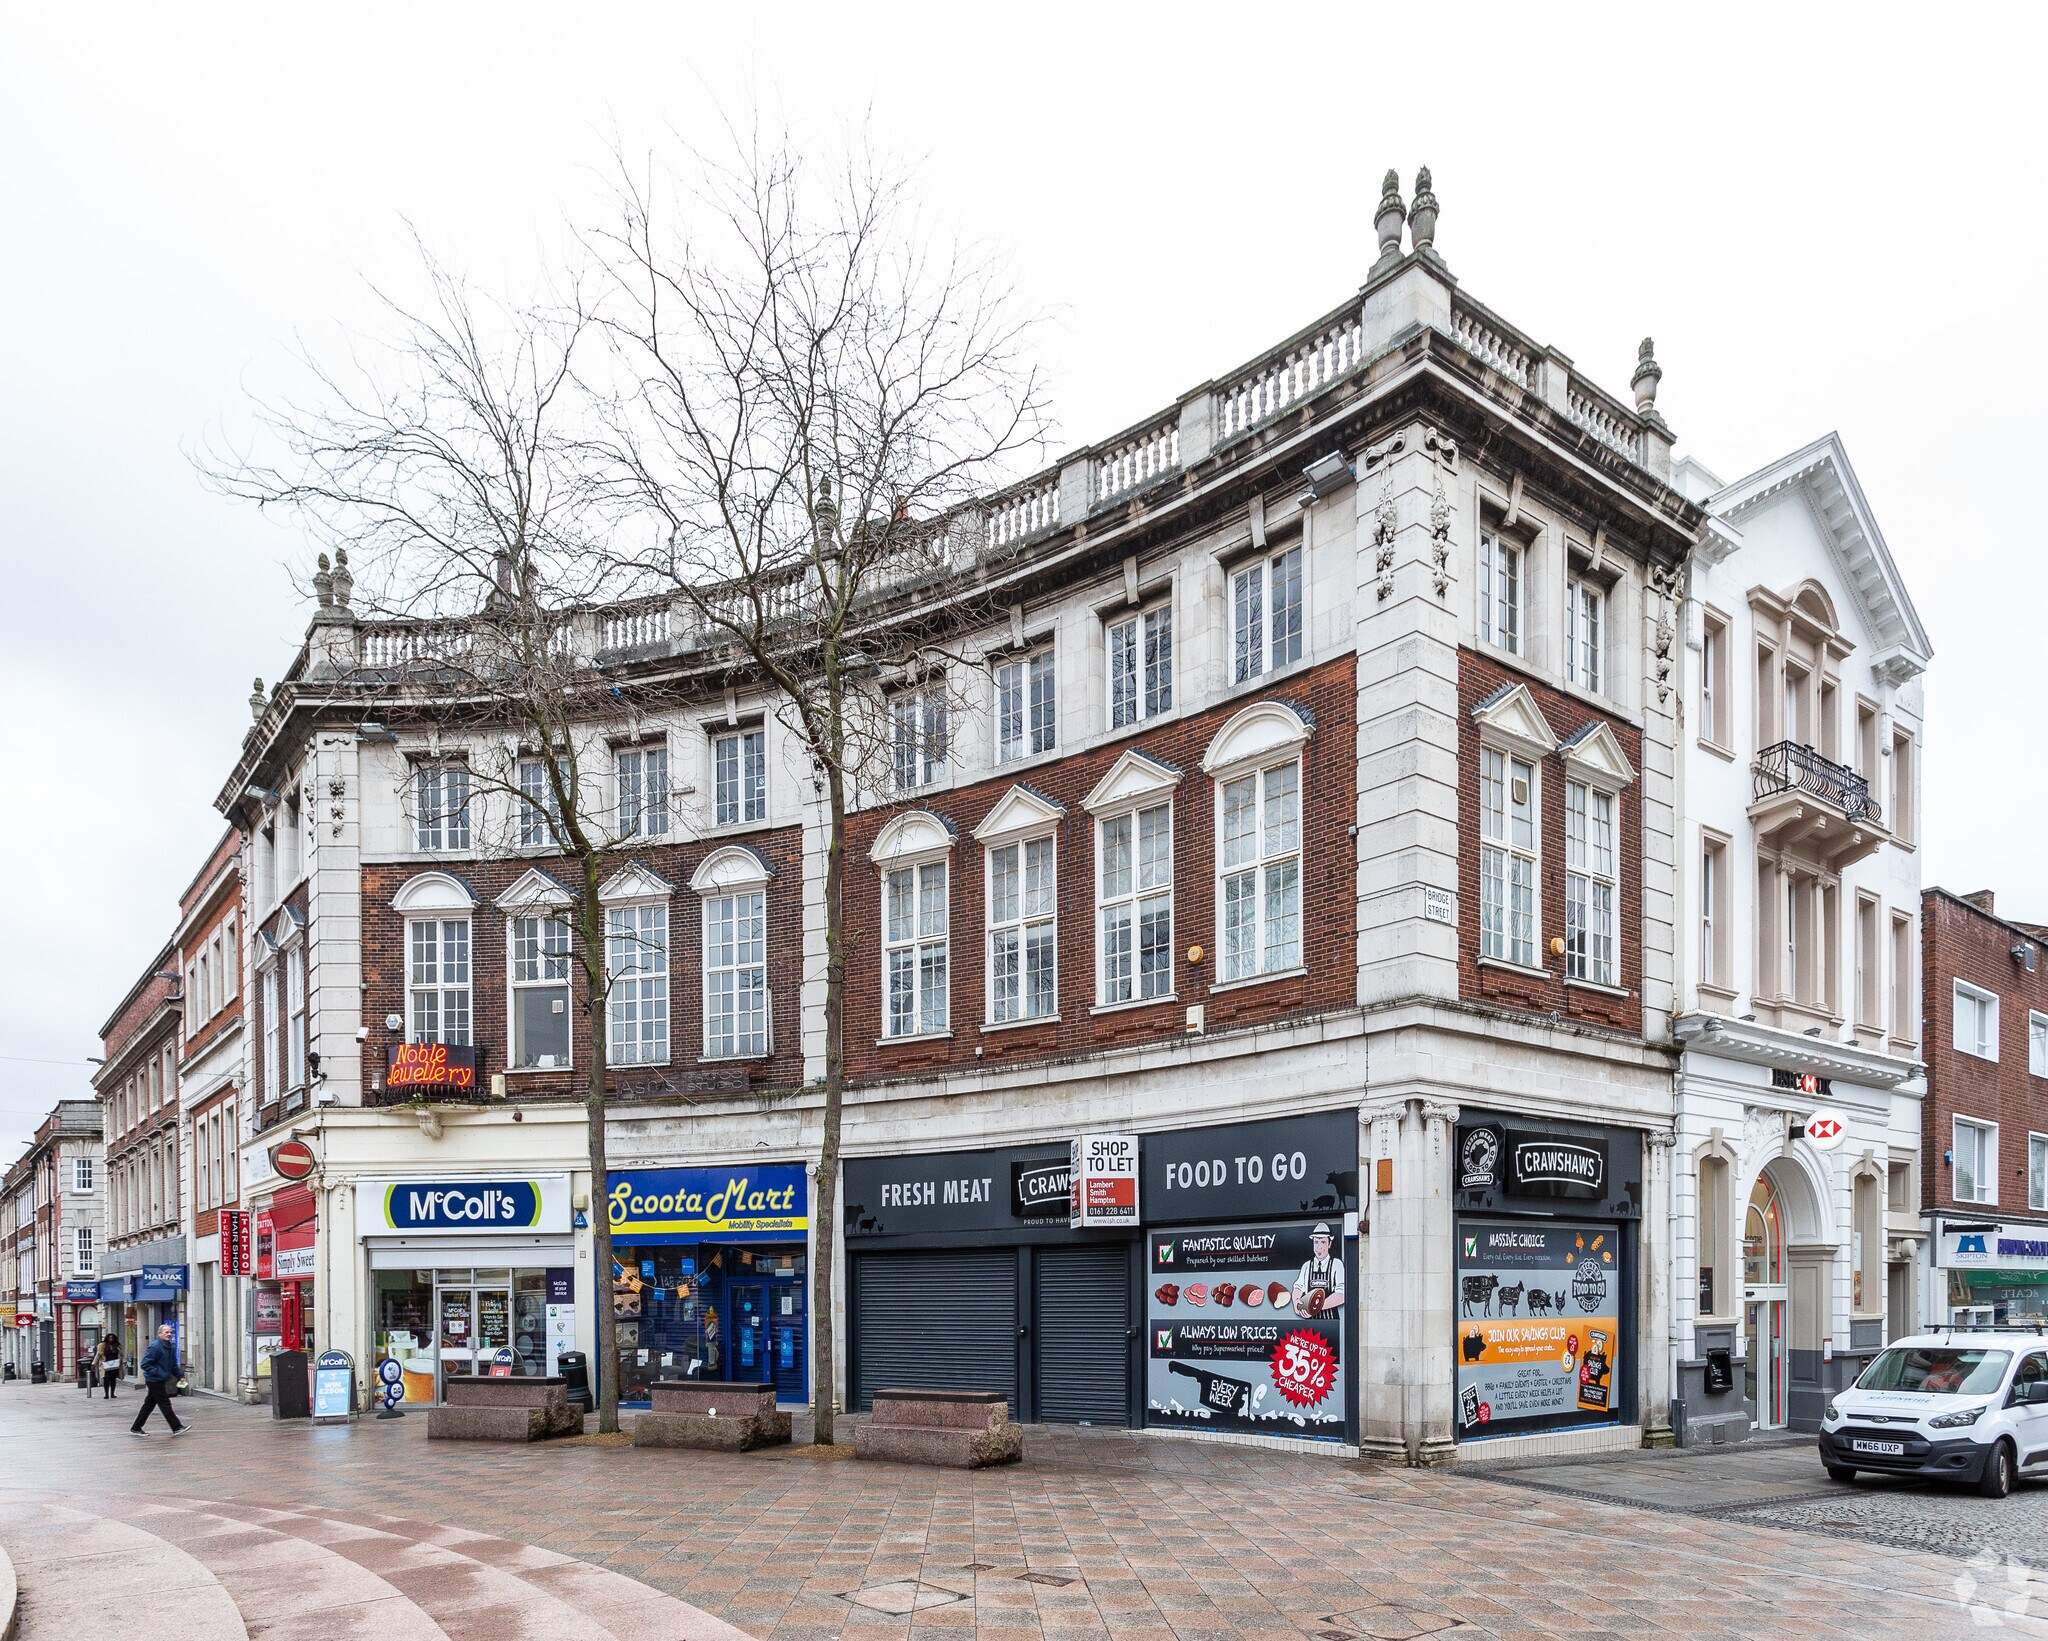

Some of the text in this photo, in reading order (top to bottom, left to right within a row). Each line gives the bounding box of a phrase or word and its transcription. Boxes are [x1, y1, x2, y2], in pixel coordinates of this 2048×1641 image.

[1427, 889, 1449, 905] BRIDGE
[1427, 904, 1449, 919] STREET
[396, 1042, 447, 1065] Noble
[387, 1060, 471, 1087] Jewellery
[1772, 1069, 1802, 1090] HSBC
[1091, 1140, 1129, 1156] SHOP
[1464, 1131, 1494, 1154] FRESH MEAT
[1087, 1157, 1105, 1172] TO
[1109, 1157, 1134, 1172] LET
[1166, 1151, 1307, 1189] FOOD TO GO
[1524, 1151, 1595, 1177] CRAWSHAWS
[881, 1178, 992, 1207] FRESH MEAT
[1089, 1197, 1116, 1205] Hampton
[410, 1190, 515, 1221] McColl's
[608, 1178, 795, 1226] Scoota Mart
[1089, 1207, 1103, 1215] 0161
[1106, 1207, 1118, 1215] 228
[1119, 1207, 1134, 1215] 6411
[728, 1219, 793, 1230] Mobility Specialists
[241, 1218, 249, 1268] TATTOO
[1182, 1234, 1276, 1252] FANTASTIC QUALITY
[1489, 1231, 1546, 1248] MASSIVE CHOICE
[278, 1253, 296, 1273] Simply
[1186, 1256, 1208, 1267] Prepared
[1210, 1255, 1216, 1267] by
[1227, 1255, 1245, 1263] skilled
[1247, 1254, 1268, 1263] butchers
[1483, 1252, 1494, 1264] Every
[1503, 1253, 1514, 1264] Every
[1523, 1253, 1534, 1264] Every
[1573, 1281, 1605, 1296] FOOD TO GO
[1180, 1325, 1278, 1340] ALWAYS LOW PRICES
[1488, 1326, 1566, 1343] JOIN OUR SAVINGS CLUB
[1192, 1344, 1265, 1356] Why pay Supermarket prices?
[1290, 1335, 1327, 1357] WE'RE UP TO
[1279, 1343, 1325, 1387] 35%
[1517, 1369, 1531, 1378] GREAT
[1210, 1379, 1239, 1398] EVERY
[1279, 1376, 1315, 1400] CHEAPER
[1499, 1381, 1514, 1389] FAMILY
[1515, 1380, 1529, 1389] EVENTS
[1534, 1378, 1548, 1387] EASTER
[1552, 1377, 1572, 1385] CHRISTMAS
[1209, 1391, 1233, 1408] WEEK
[1499, 1391, 1514, 1400] LITTLE
[1515, 1390, 1528, 1399] EVERY
[1529, 1389, 1540, 1398] WEEK
[1541, 1388, 1552, 1397] HELPS
[1495, 1397, 1565, 1411] AND YOU'LL SAVE EVEN MORE MONEY
[1881, 1443, 1899, 1453] UXP
